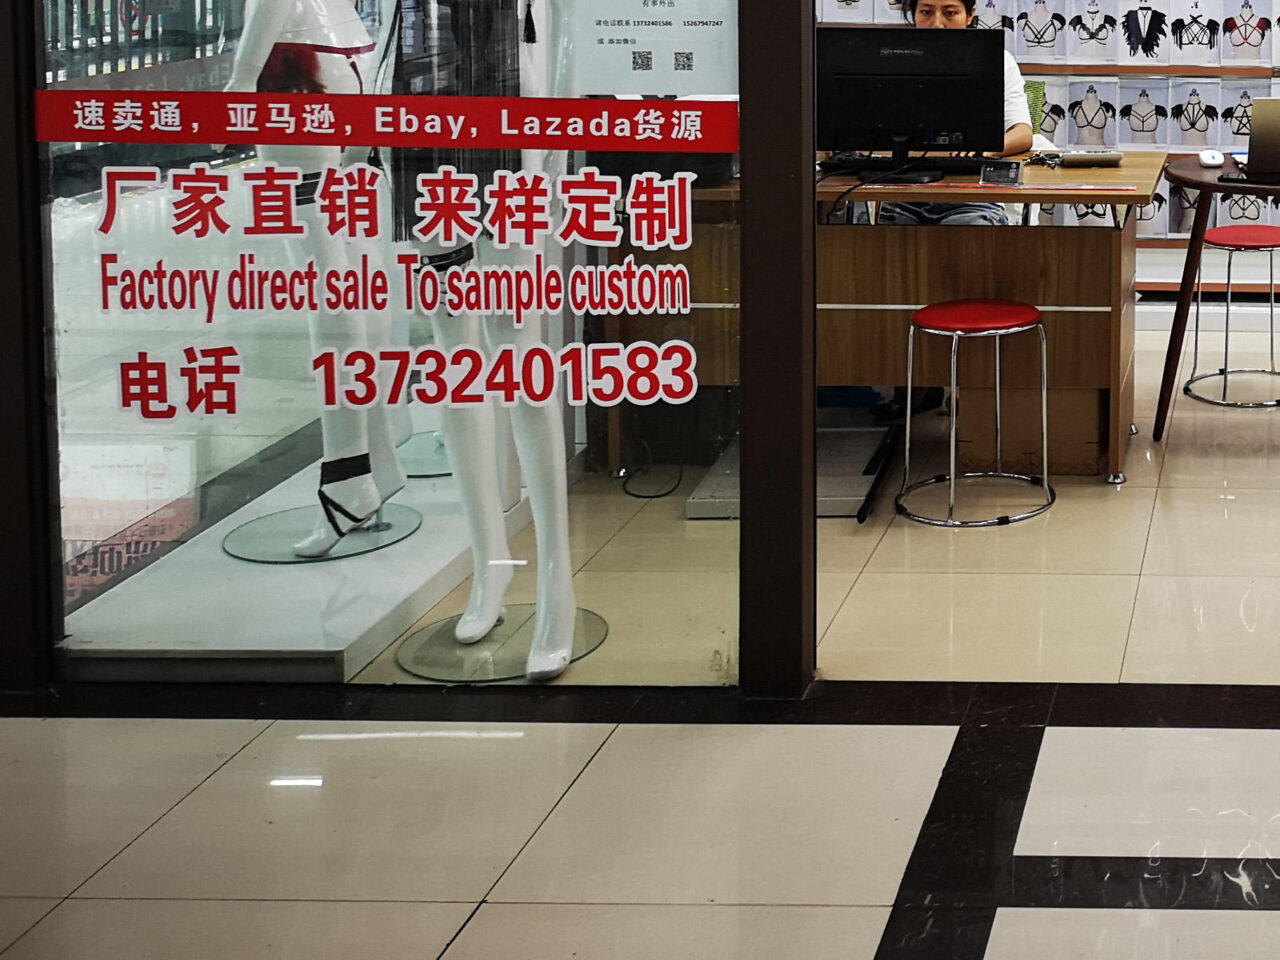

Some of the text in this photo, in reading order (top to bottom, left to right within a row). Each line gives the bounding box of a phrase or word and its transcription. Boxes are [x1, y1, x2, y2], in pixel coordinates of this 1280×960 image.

[642, 0, 675, 8] 有事外出
[99, 166, 697, 247] 厂家直销 来样定制
[101, 254, 689, 324] Factory direct sale To sample custom
[120, 344, 695, 419] 电话 13732401583
